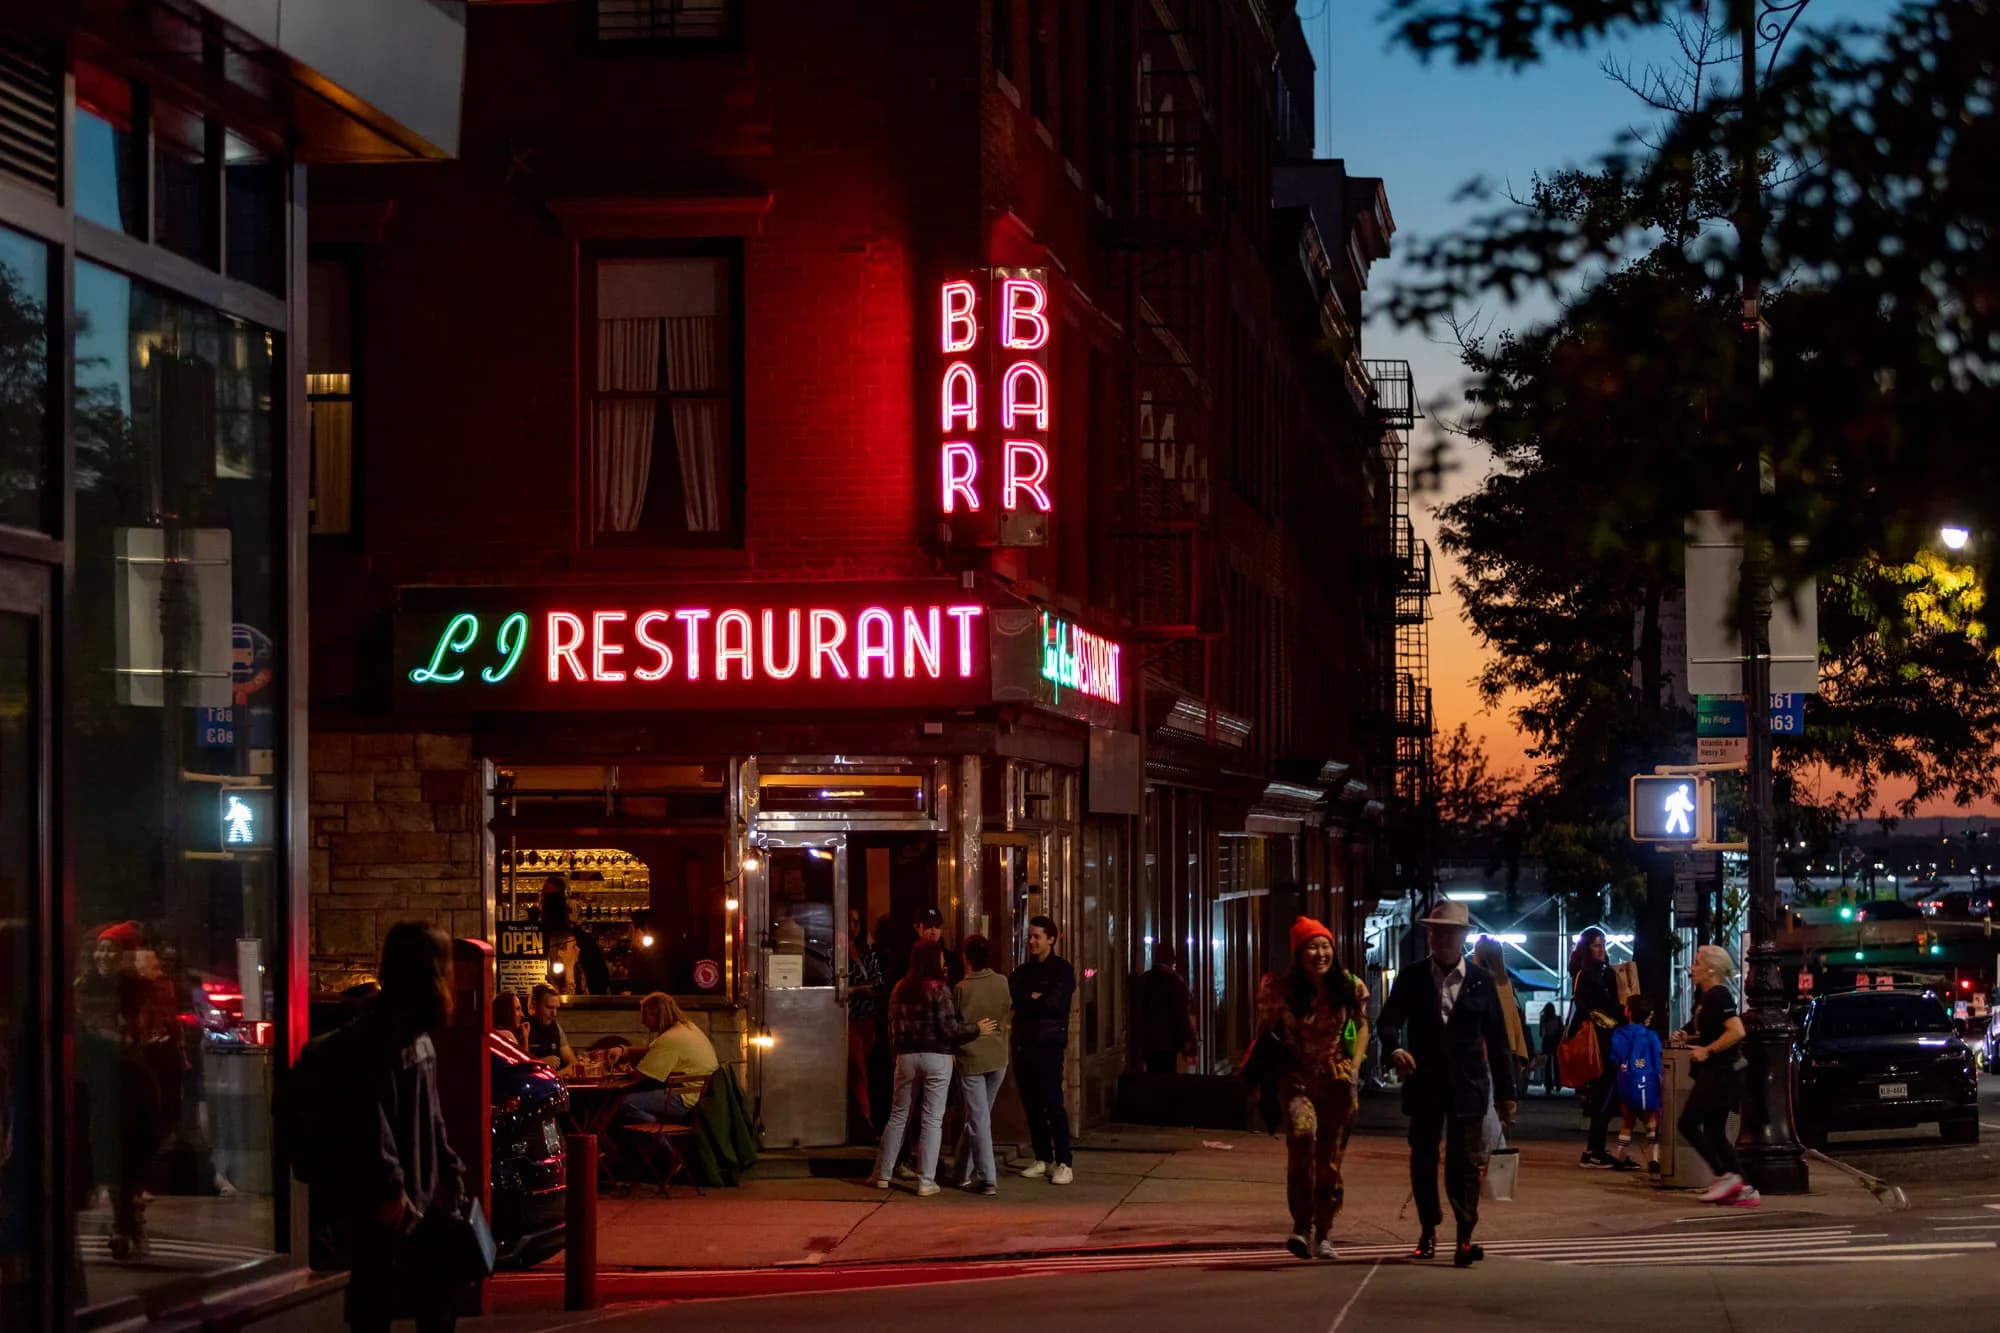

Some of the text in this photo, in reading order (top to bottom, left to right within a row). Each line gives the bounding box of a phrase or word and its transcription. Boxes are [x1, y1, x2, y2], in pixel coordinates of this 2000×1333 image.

[940, 279, 980, 513] BAR
[1001, 279, 1052, 512] BAR
[547, 606, 983, 682] RESTAURANT
[1073, 624, 1120, 705] RESTAURANT
[502, 931, 544, 955] OPEN
